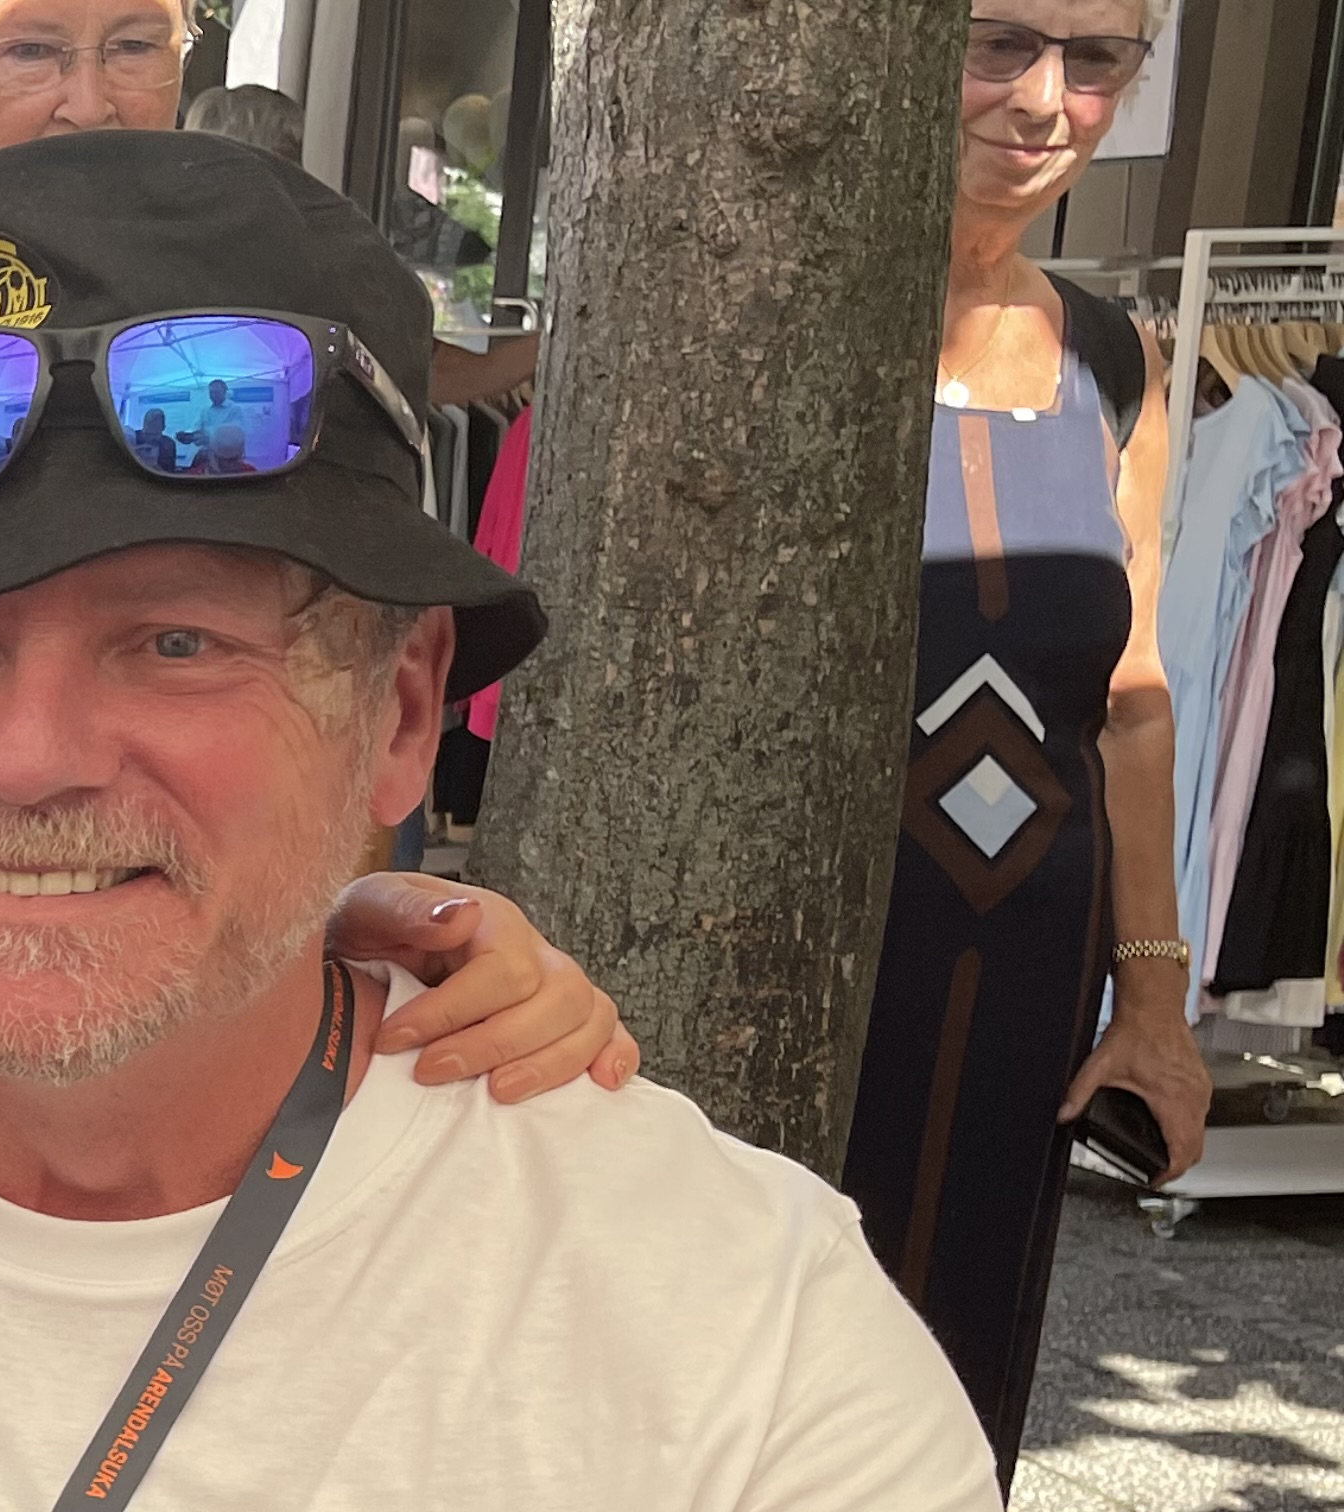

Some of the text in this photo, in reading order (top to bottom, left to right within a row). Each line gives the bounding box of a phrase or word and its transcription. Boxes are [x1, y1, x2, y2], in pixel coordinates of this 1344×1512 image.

[200, 1263, 234, 1308] MØT
[176, 1304, 211, 1344] OSS
[85, 1367, 174, 1500] ARENDALSUKA
